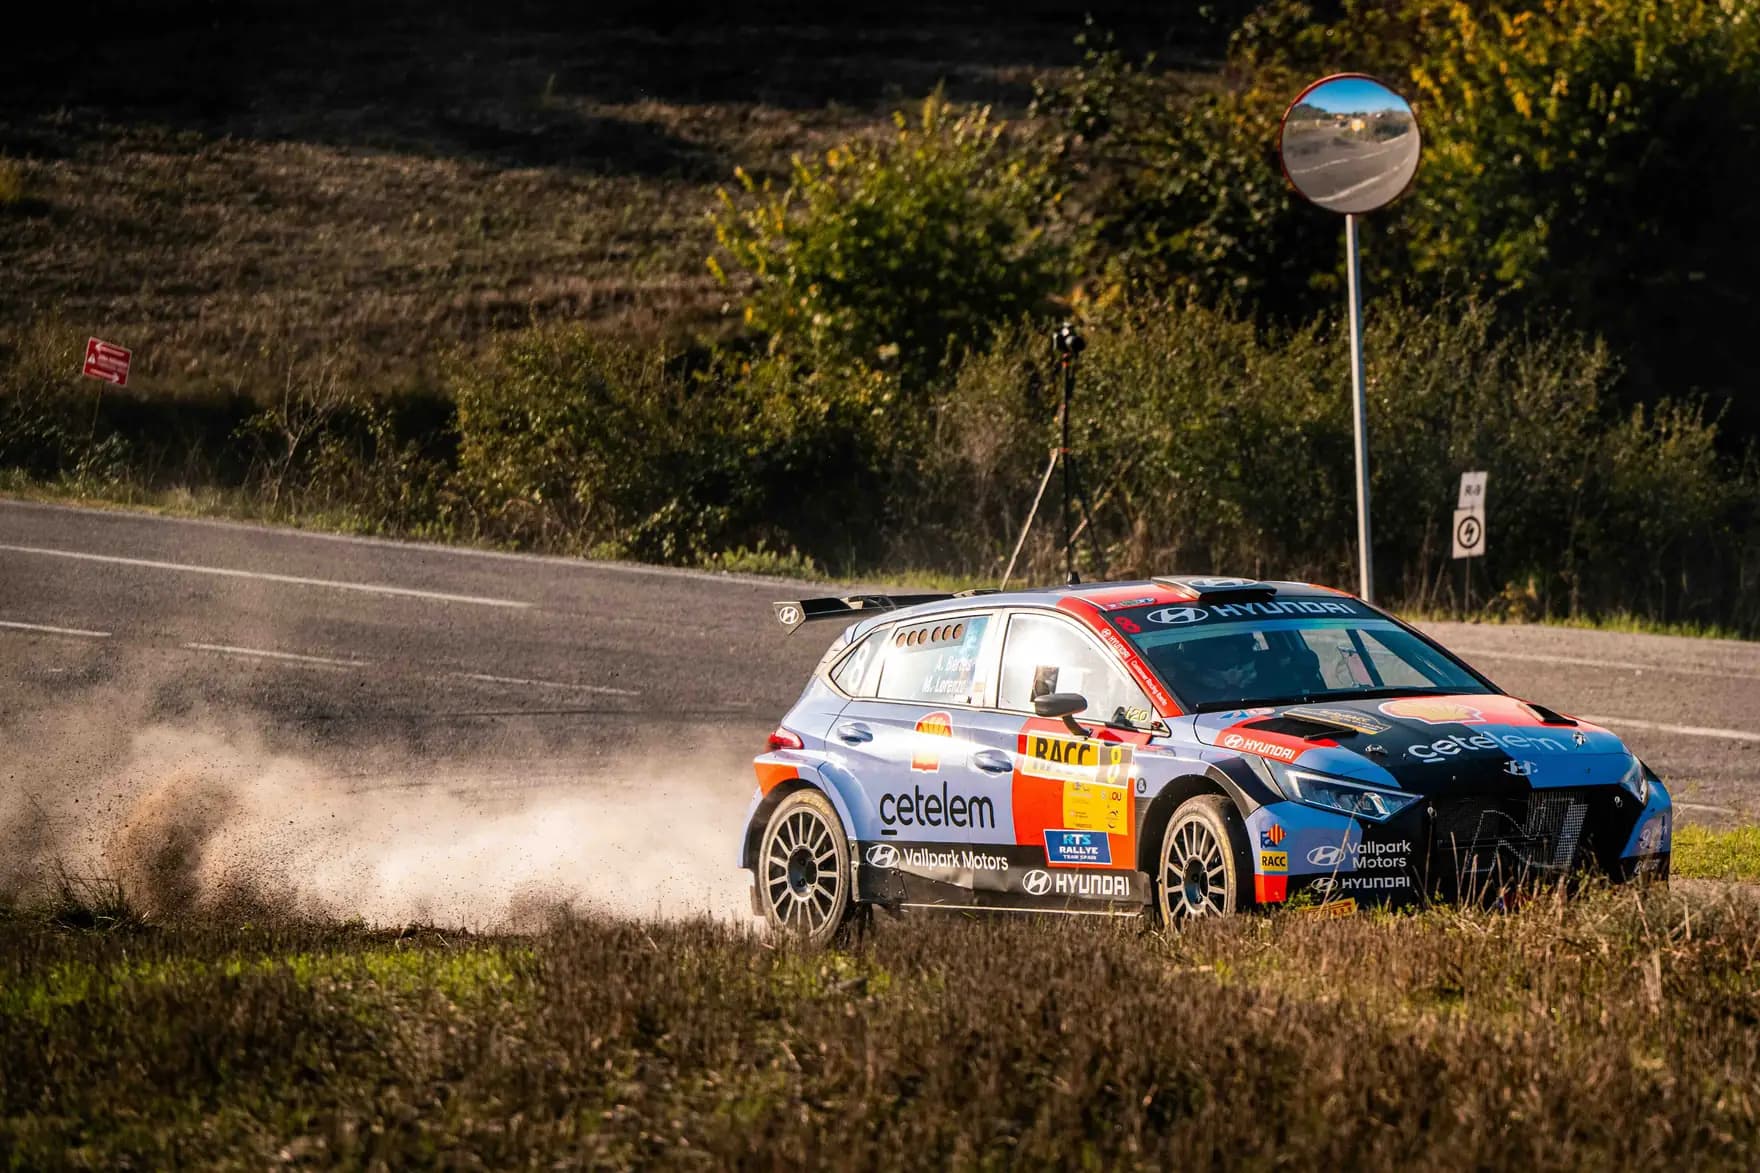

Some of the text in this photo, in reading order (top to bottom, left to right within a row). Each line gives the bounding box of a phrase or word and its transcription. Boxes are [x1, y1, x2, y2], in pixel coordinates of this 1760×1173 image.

[1211, 601, 1357, 617] HYUNDAI
[1114, 616, 1141, 634] 8
[1243, 740, 1296, 760] HYUNDAI
[1408, 731, 1568, 762] cetelem
[1034, 737, 1091, 767] RACC
[1107, 746, 1122, 784] 8
[880, 781, 996, 835] cetelem
[1063, 833, 1092, 845] RTS
[1059, 846, 1099, 855] RALLYE
[1346, 840, 1412, 856] Vallpark
[903, 848, 1009, 871] Vallpark Motors
[1261, 856, 1287, 867] RACC
[1352, 857, 1407, 869] Motors
[1055, 873, 1130, 896] HYUNDAI
[1341, 876, 1410, 889] HYUNDAI
